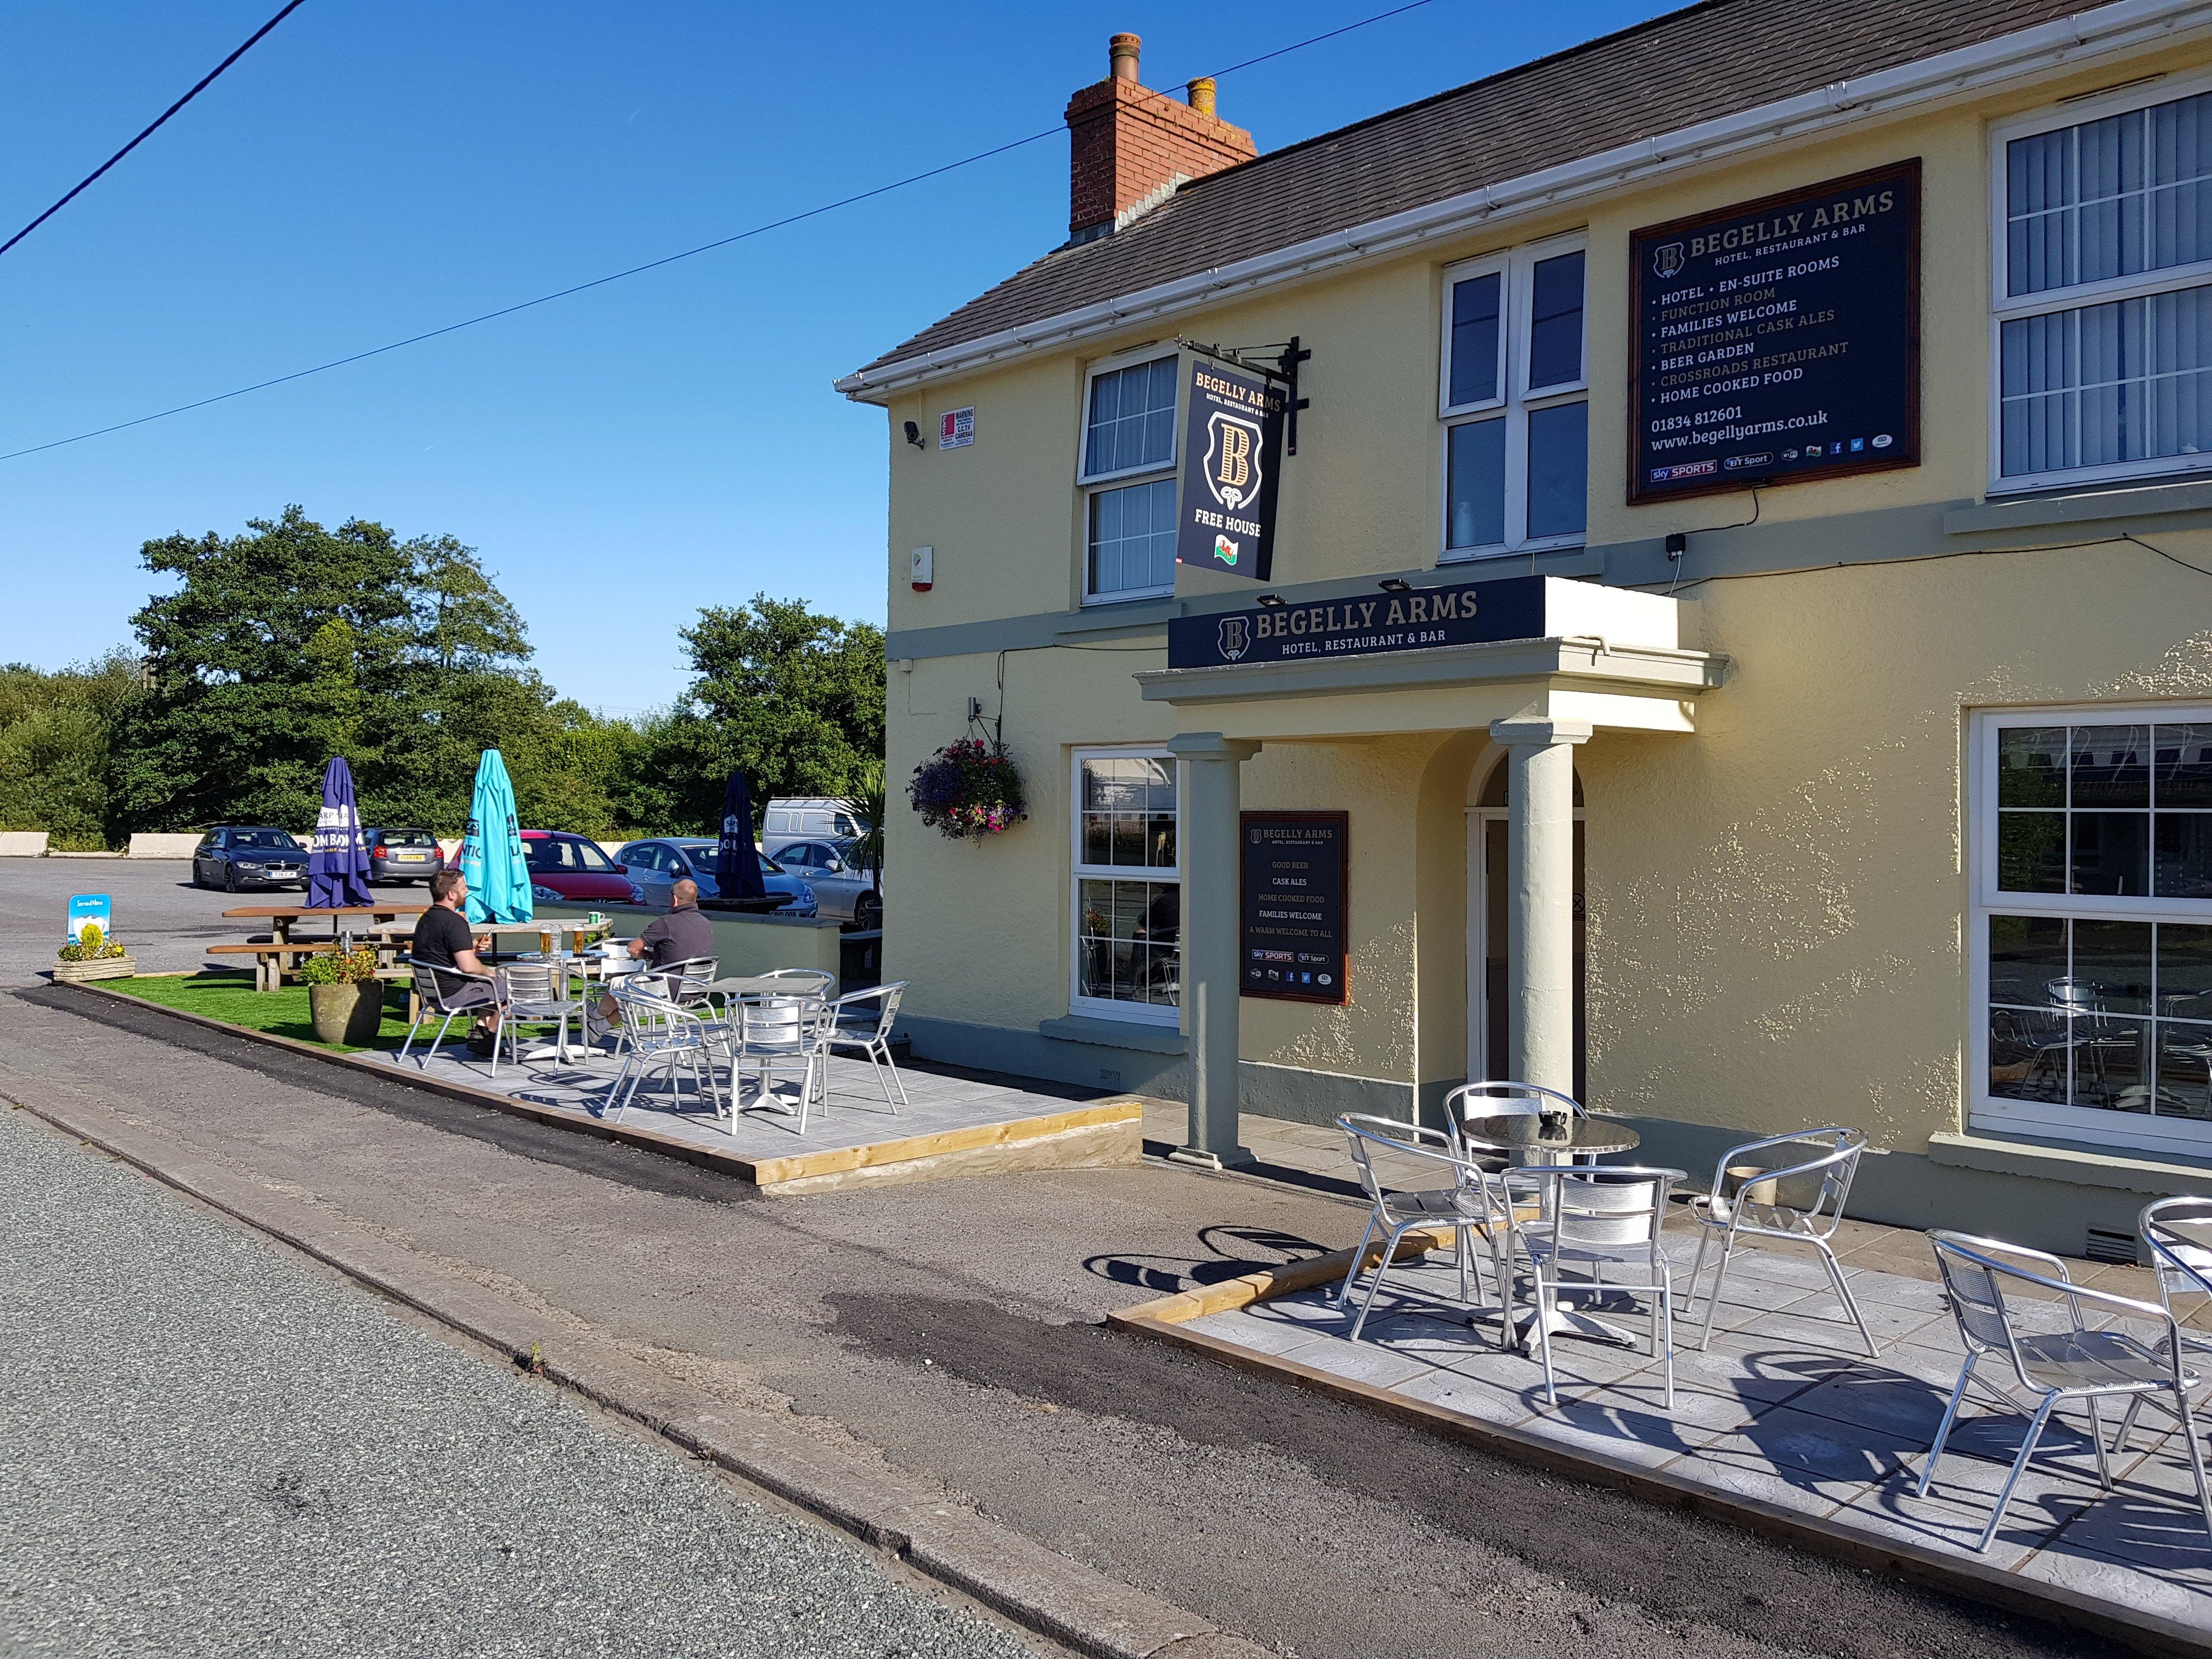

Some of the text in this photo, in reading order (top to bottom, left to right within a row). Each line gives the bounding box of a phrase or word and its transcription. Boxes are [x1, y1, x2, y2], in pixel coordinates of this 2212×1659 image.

[1690, 191, 1894, 258] BEGELLY ARMS
[1662, 247, 1677, 270] B
[1715, 223, 1866, 266] HOTEL, RESTAURANT & BAR
[1661, 256, 1839, 306] HOTEL EN-SUITE ROOMS
[1661, 287, 1776, 322] FUNCTION ROOM
[1661, 300, 1797, 338] FAMILIES WELCOME
[1661, 309, 1835, 355] TRADITIONAL CASK ALES
[1661, 342, 1754, 371] BEER GARDEN
[1661, 342, 1849, 387] CROSSROADS RESTAURANT
[1195, 372, 1281, 413] BEGELLY ARMS
[1661, 368, 1803, 404] HOME COOKED FOOD
[1206, 393, 1223, 405] HOTEL,
[1224, 399, 1254, 415] RESTAURANT
[1651, 406, 1742, 433] 01834 812601
[1651, 410, 1828, 451] www.begellyarms.co.uk
[955, 430, 973, 439] CAMERAS
[1217, 422, 1250, 487] B
[1730, 455, 1768, 467] BT Sport
[1653, 462, 1714, 481] sky SPORTS
[1194, 508, 1261, 538] FREE HOUSE
[1256, 590, 1477, 639] BEGELLY ARMS
[1225, 622, 1242, 650] B
[1282, 630, 1446, 655] HOTEL, RESTAURANT & BAR
[1263, 829, 1333, 839] BEGELLY ARMS
[1278, 894, 1305, 902] COOKED
[1306, 895, 1325, 904] FOOD
[1259, 910, 1322, 920] FAMILIES WELCOME
[1276, 928, 1308, 936] WELCOME
[1254, 950, 1292, 961] sky SPORTS
